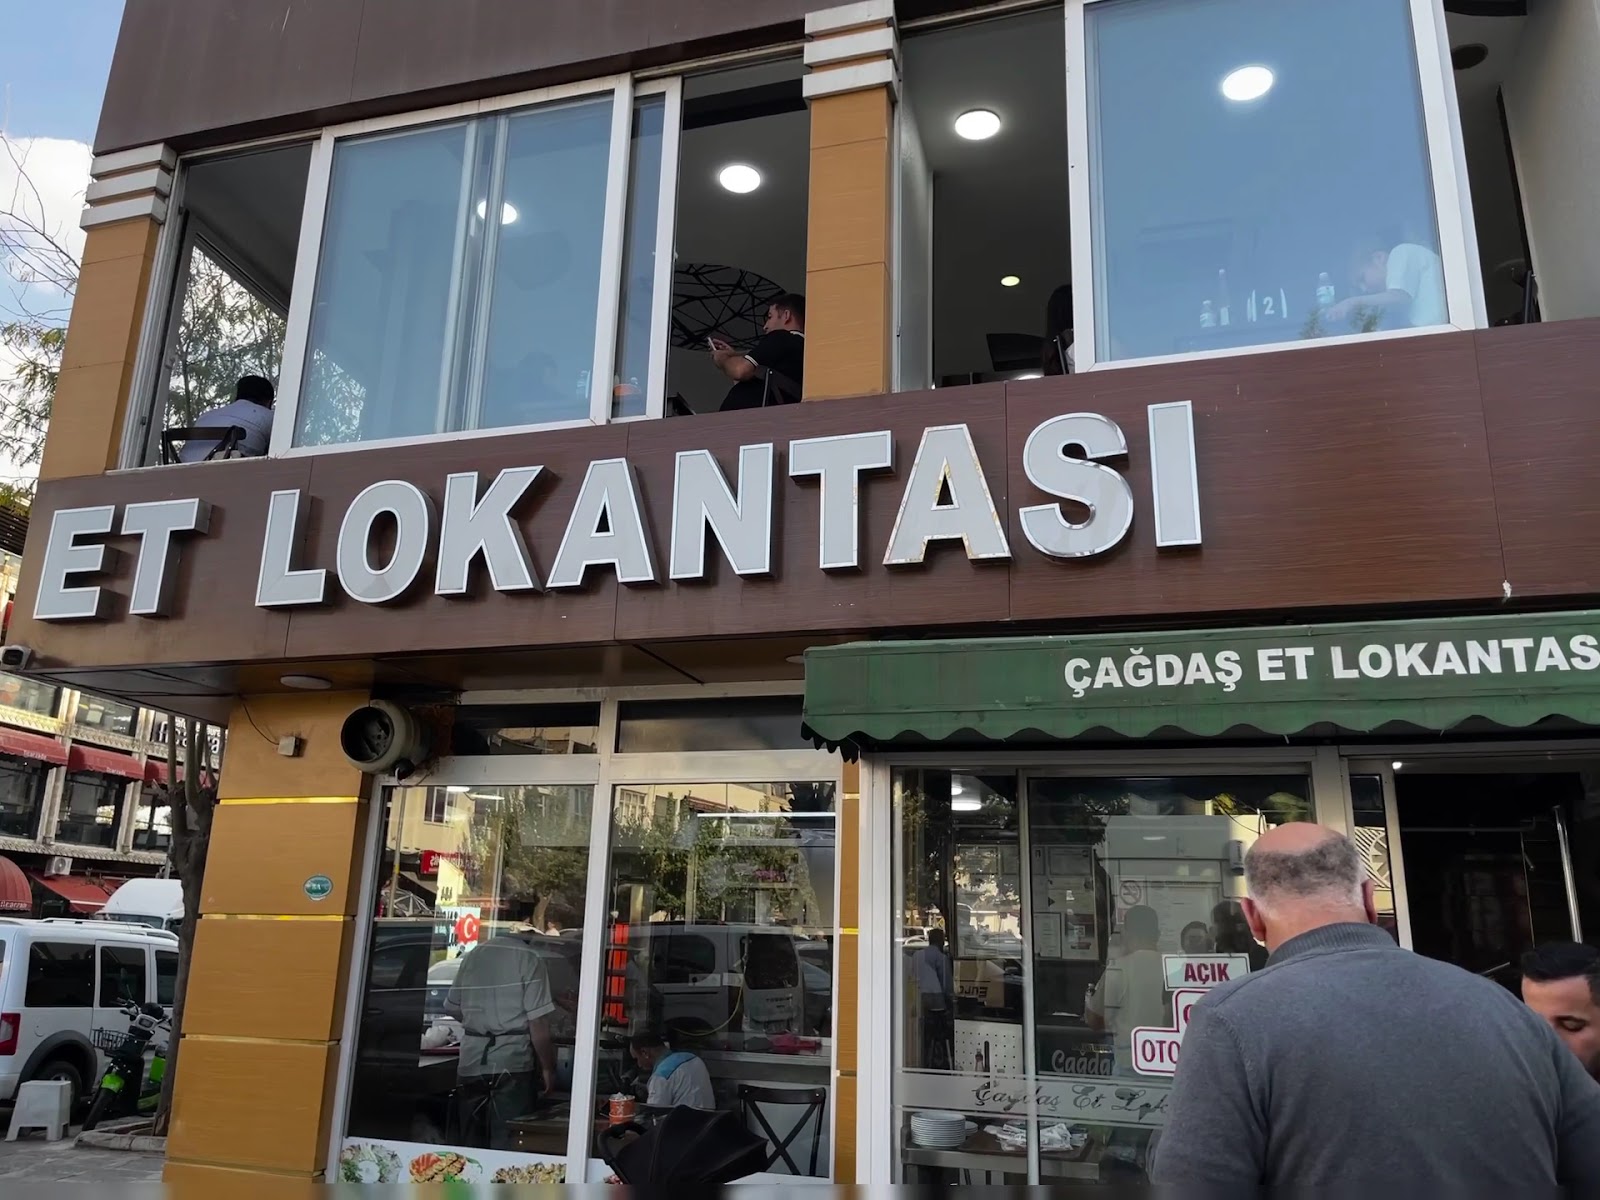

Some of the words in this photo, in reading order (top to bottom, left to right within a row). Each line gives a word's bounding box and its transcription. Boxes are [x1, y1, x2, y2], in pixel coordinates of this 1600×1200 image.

[33, 497, 206, 622] ET
[255, 399, 1203, 608] LOKANTASI
[1064, 647, 1243, 698] ÇAĞDAŞ
[1257, 646, 1315, 682] ET
[1331, 634, 1600, 680] LOKANTAS
[1184, 962, 1231, 985] AÇIK
[1072, 1083, 1106, 1111] Et
